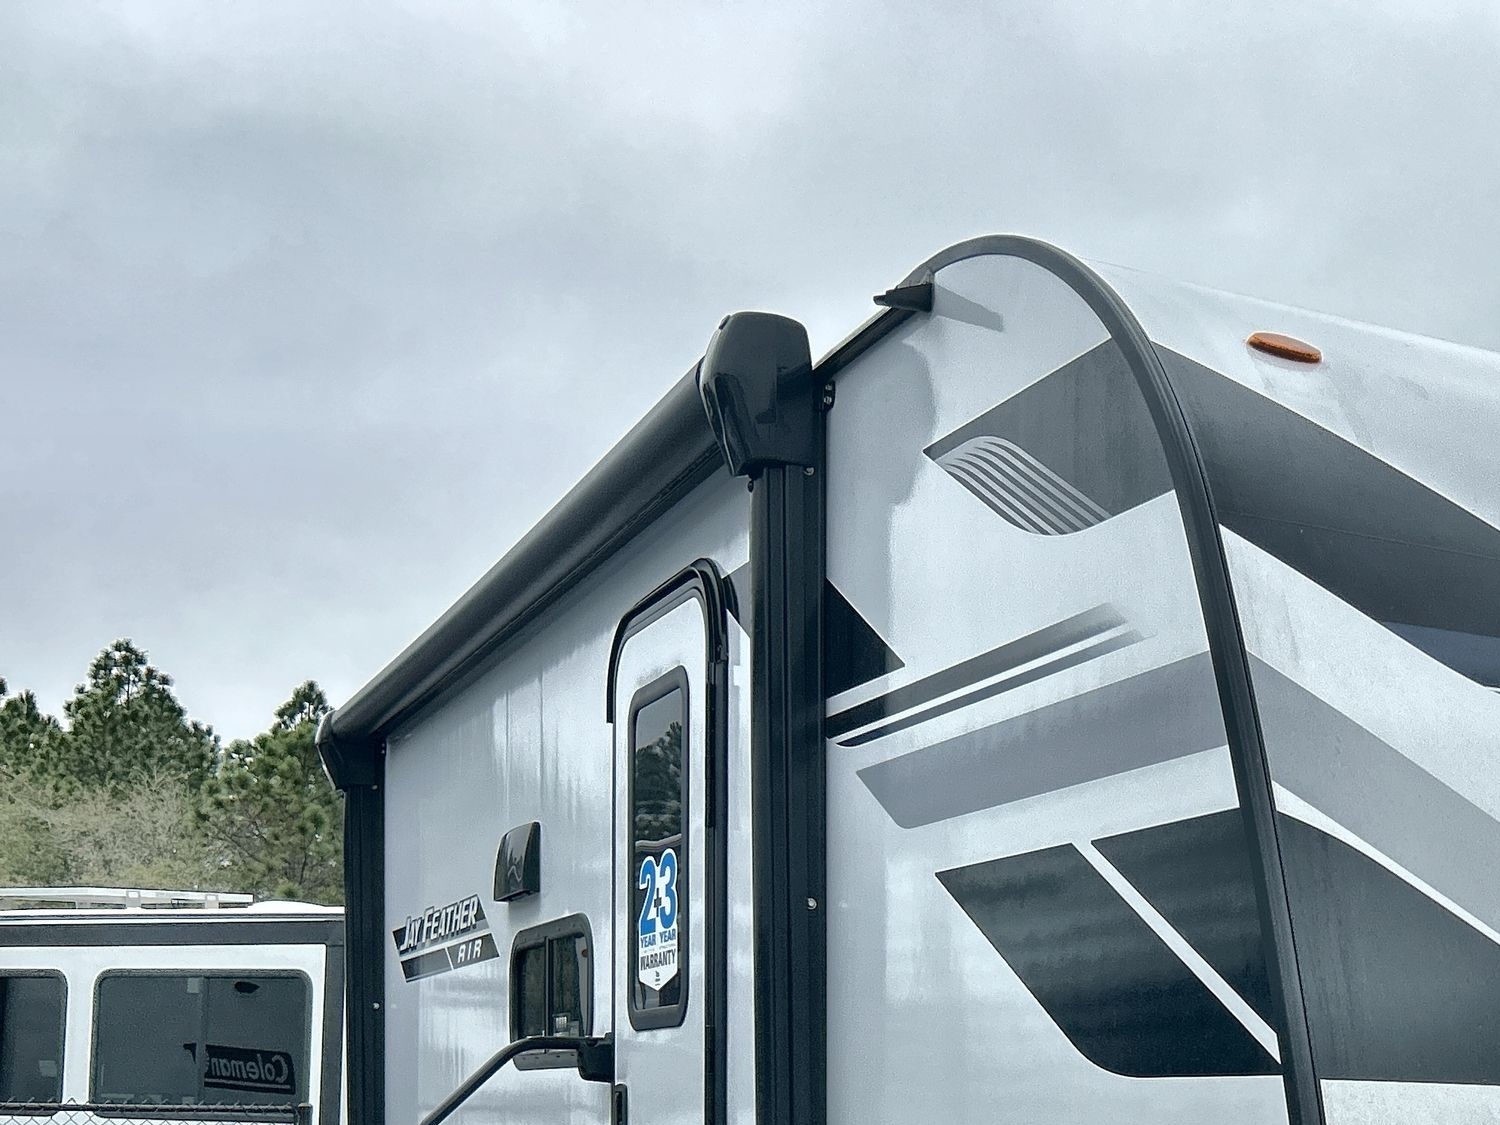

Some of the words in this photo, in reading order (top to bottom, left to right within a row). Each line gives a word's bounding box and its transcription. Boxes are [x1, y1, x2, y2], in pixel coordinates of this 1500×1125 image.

[400, 917, 422, 951] JAY
[422, 896, 478, 943] FEATHER
[640, 934, 656, 948] YEAR
[659, 929, 676, 943] YEAR
[457, 939, 482, 963] AIR
[640, 949, 676, 971] WARRANTY
